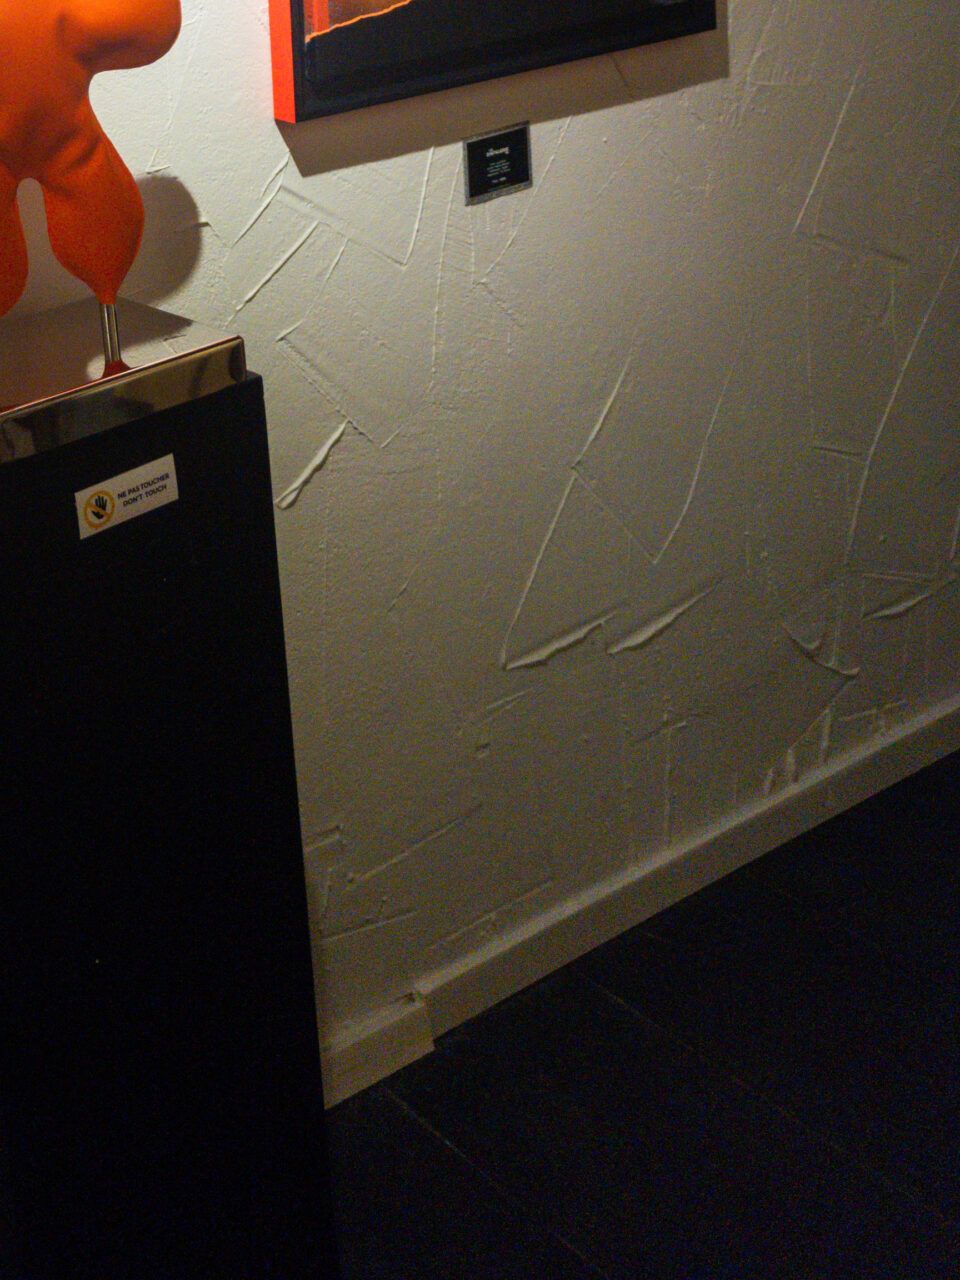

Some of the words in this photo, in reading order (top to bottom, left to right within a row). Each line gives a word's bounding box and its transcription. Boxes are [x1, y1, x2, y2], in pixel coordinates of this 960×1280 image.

[117, 491, 127, 499] NE
[128, 485, 140, 495] PAS
[140, 472, 170, 489] TOUCHER
[123, 493, 143, 507] DON'T
[145, 484, 167, 498] TOUCH
